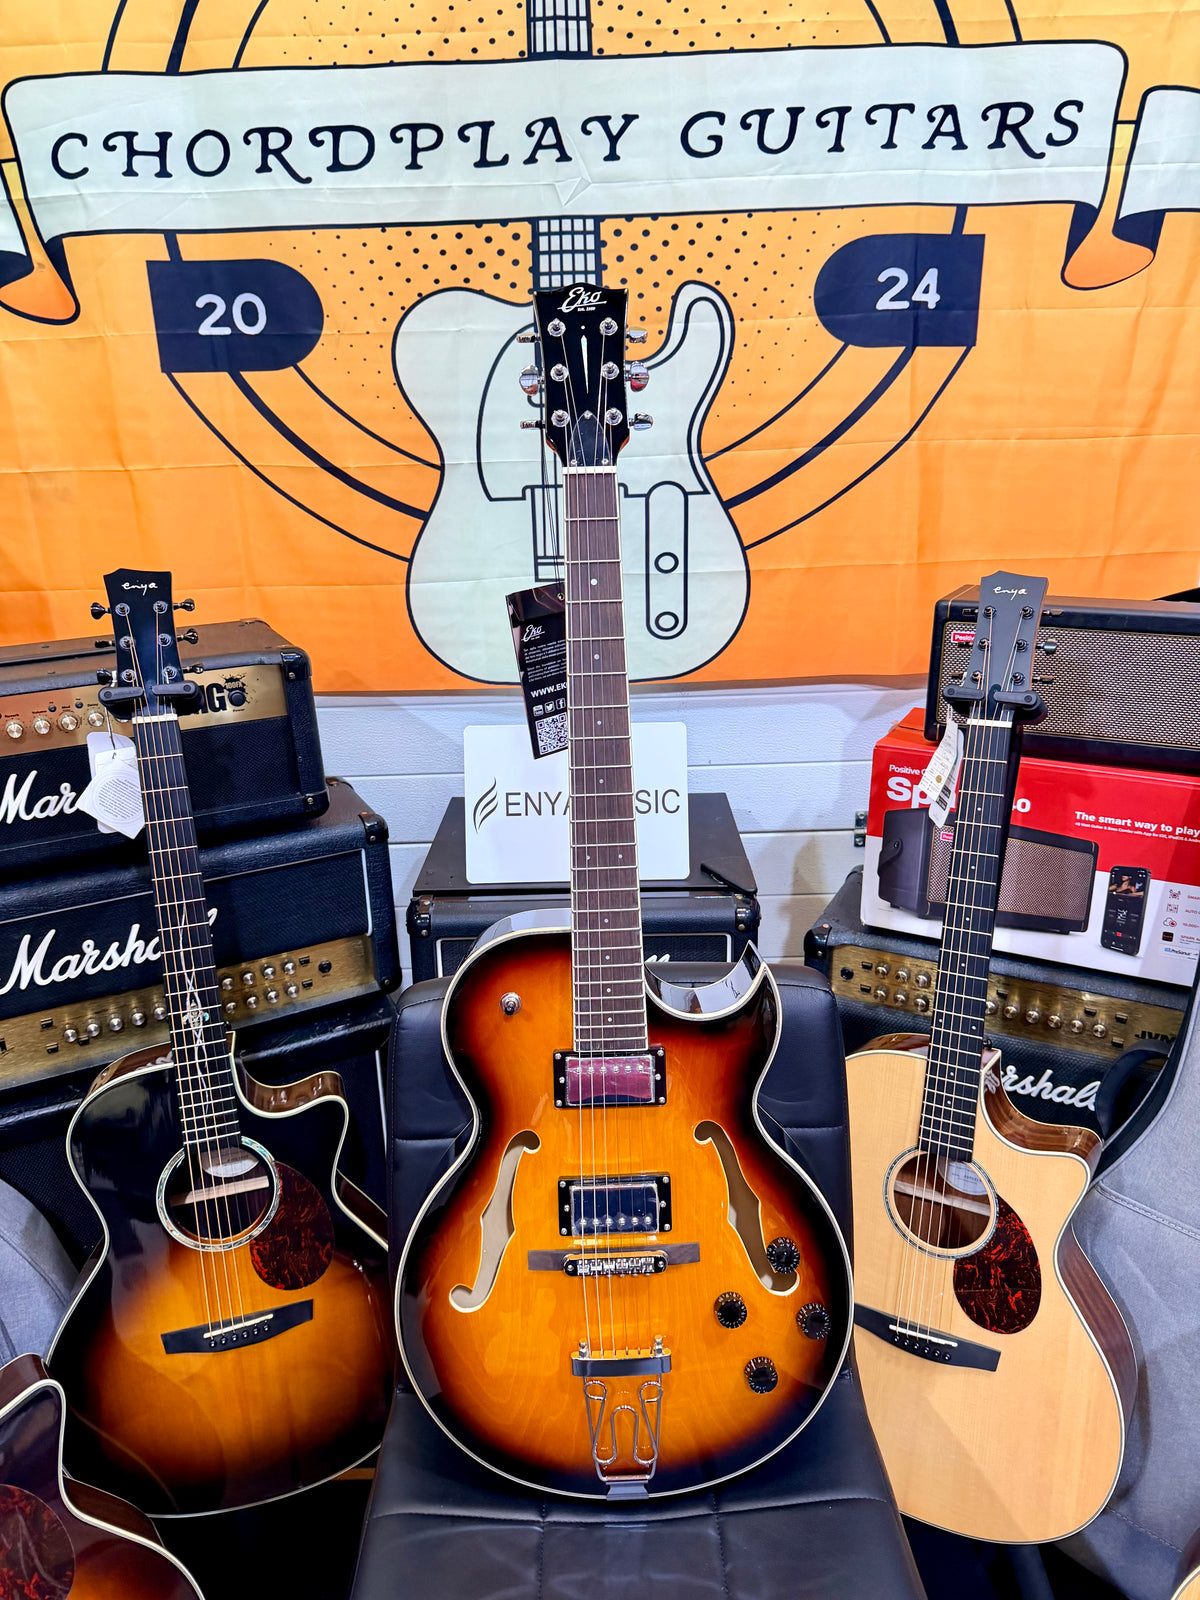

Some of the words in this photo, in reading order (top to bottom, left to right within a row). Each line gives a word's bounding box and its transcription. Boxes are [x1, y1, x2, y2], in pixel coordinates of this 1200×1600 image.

[50, 113, 640, 183] CHORDPLAY
[680, 99, 1085, 159] GUITARS
[557, 286, 607, 313] Eko
[876, 266, 941, 311] 24
[195, 292, 269, 336] 20
[121, 582, 158, 596] enya
[993, 586, 1028, 601] enya
[530, 681, 568, 699] WWW.EK
[888, 764, 921, 776] Positive
[0, 770, 79, 825] Mar
[634, 788, 681, 815] SIC
[1012, 798, 1031, 813] 0
[1074, 811, 1096, 822] The
[1098, 815, 1132, 827] smart
[1134, 820, 1158, 832] way
[1160, 823, 1173, 832] to
[1175, 826, 1200, 838] play
[0, 908, 217, 995] Marsh
[1001, 1065, 1101, 1112] rshal
